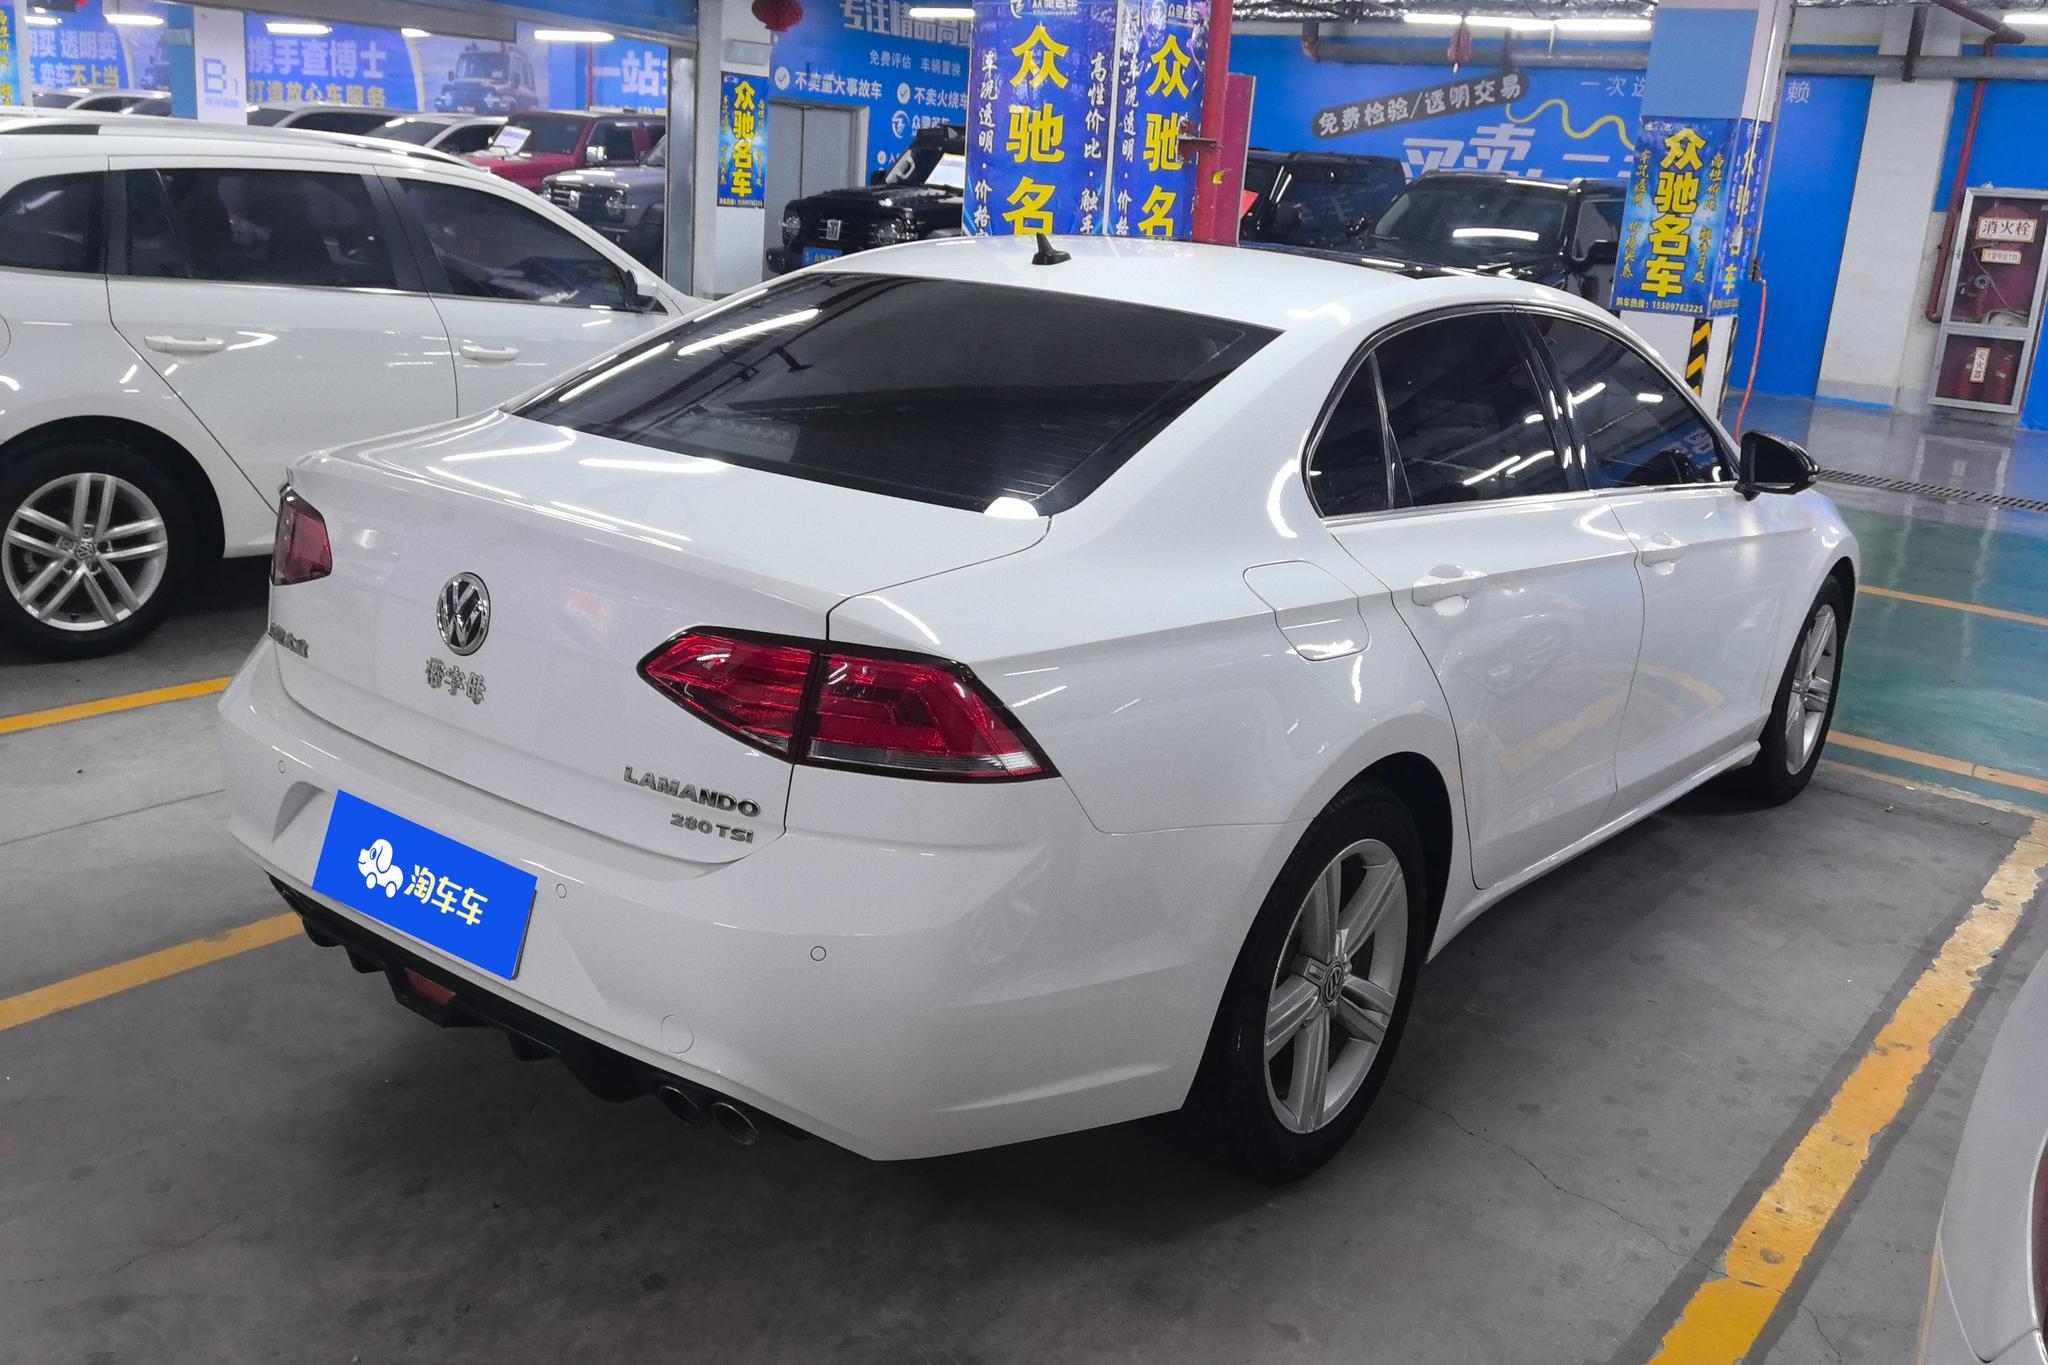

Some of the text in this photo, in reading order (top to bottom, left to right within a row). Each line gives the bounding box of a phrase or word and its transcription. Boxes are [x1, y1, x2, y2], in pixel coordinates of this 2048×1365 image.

[249, 36, 387, 79] 携手查博士
[870, 49, 912, 70] 免费评估
[794, 70, 883, 101] 不卖重大事故车
[1318, 73, 1521, 137] 免费检验/透明交易
[731, 81, 756, 197] 众驰名车
[1640, 127, 1707, 298] 众驰名车
[1982, 220, 2031, 236] 消火栓
[623, 765, 761, 818] LAMANDO
[669, 812, 754, 844] 280 TSI
